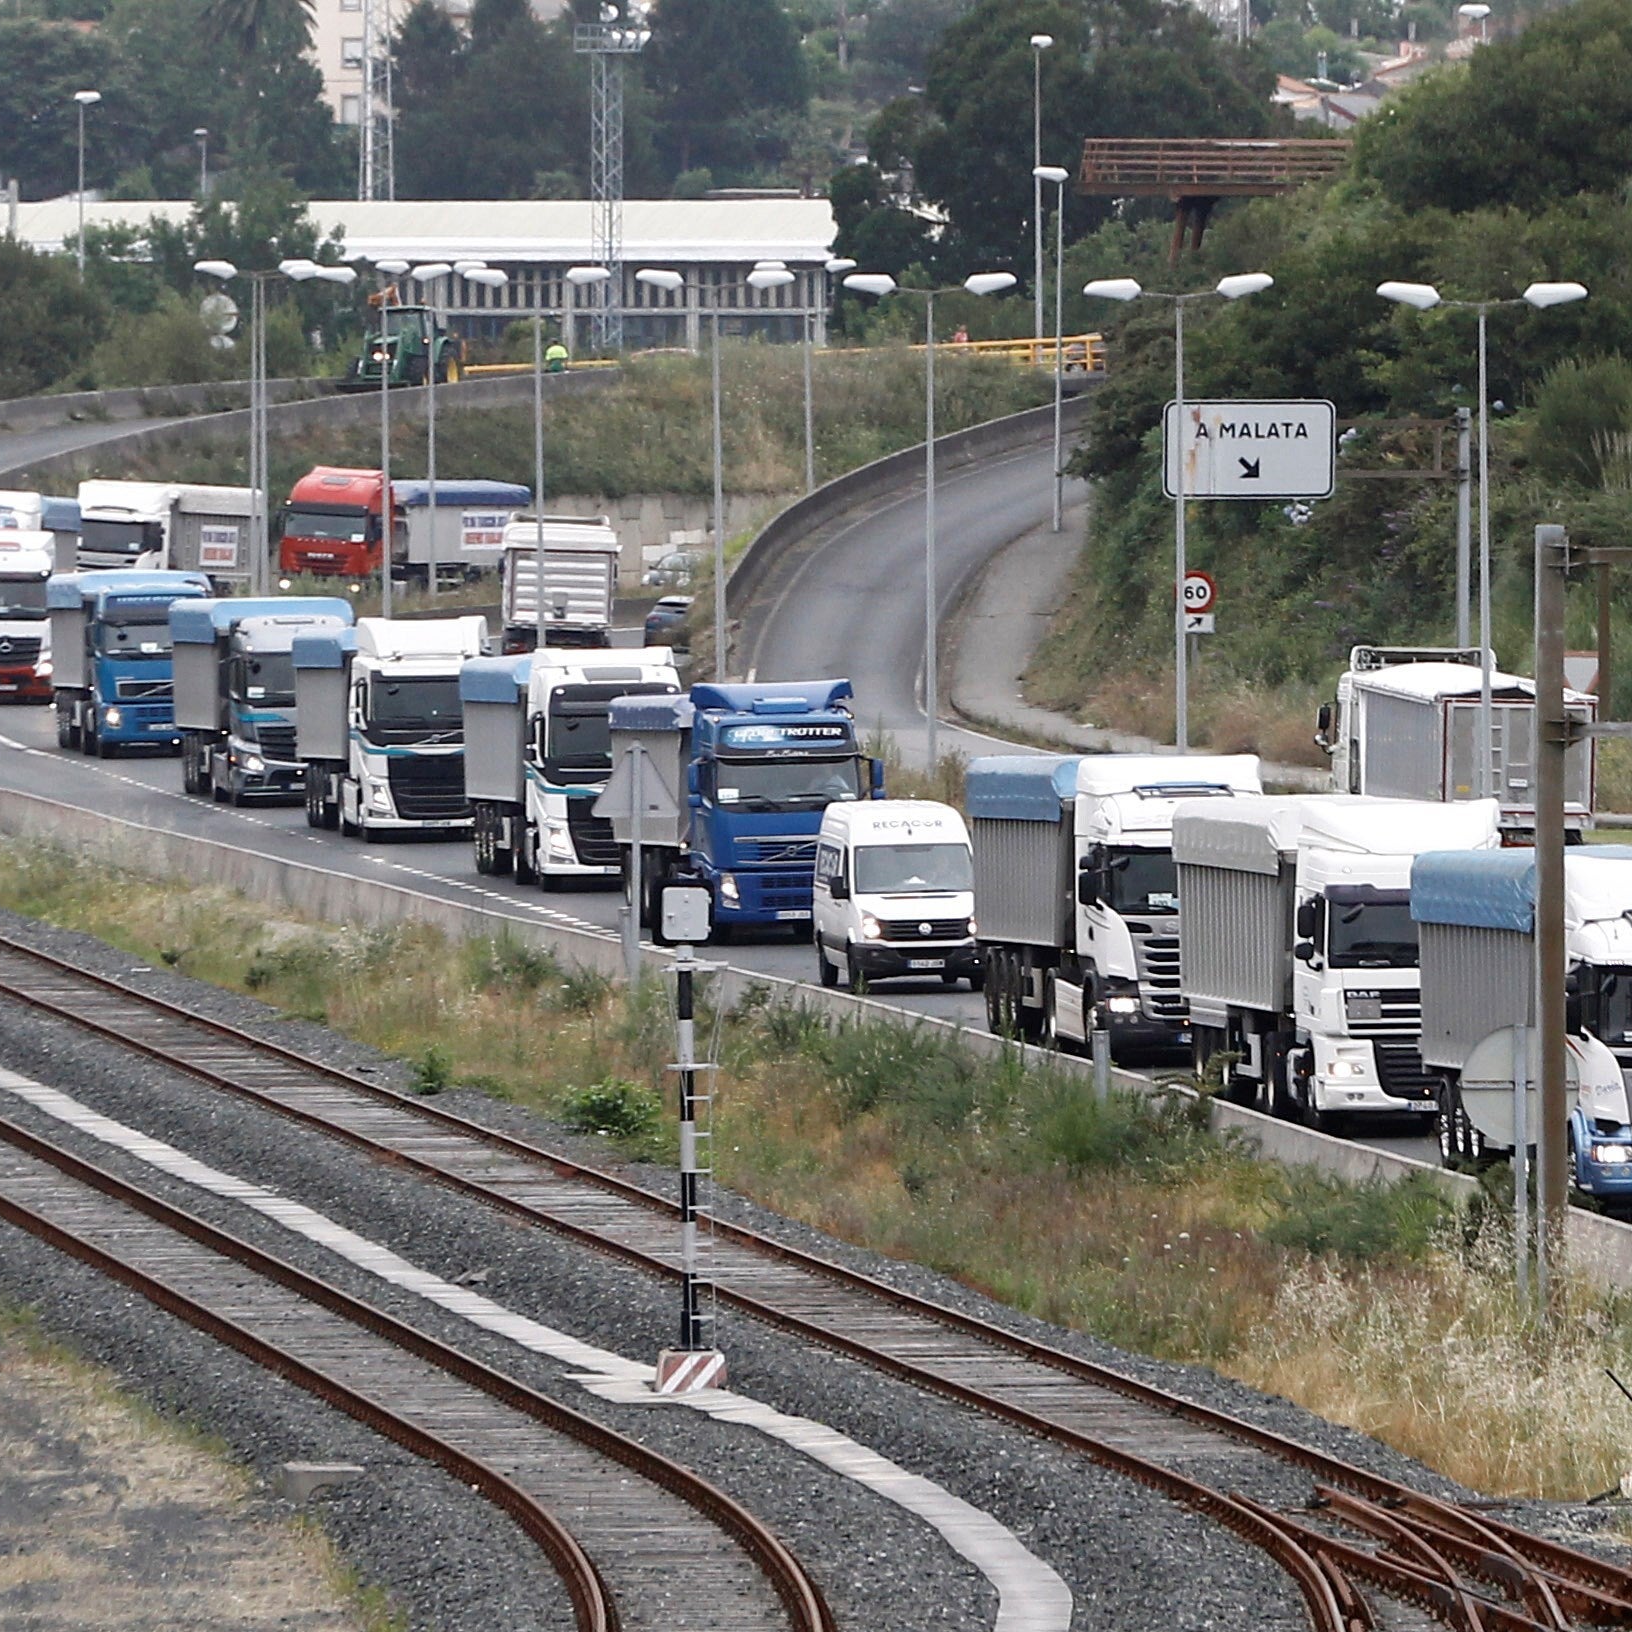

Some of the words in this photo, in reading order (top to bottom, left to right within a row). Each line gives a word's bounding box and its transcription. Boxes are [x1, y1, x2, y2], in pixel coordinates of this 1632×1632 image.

[1195, 423, 1209, 438] A
[1219, 422, 1308, 439] MALATA
[1183, 585, 1207, 600] 60
[729, 727, 843, 742] TROTTER
